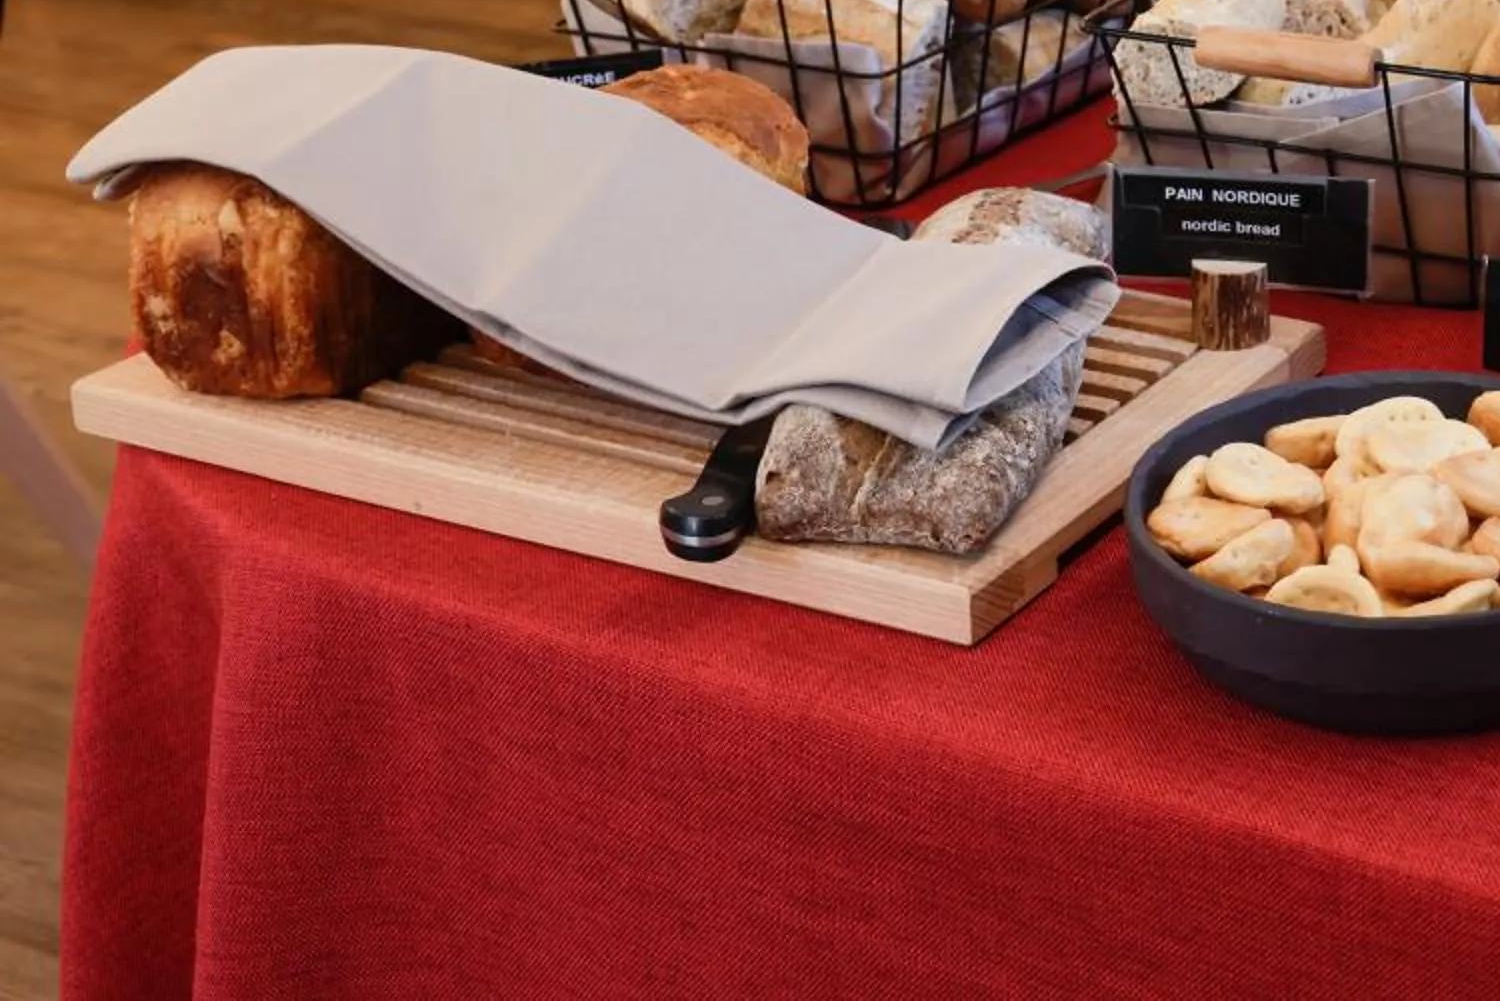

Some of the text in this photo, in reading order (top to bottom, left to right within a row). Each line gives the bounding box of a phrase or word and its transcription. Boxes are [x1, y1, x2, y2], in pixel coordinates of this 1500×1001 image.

[1164, 186, 1301, 208] PAIN NORDIQUE
[1181, 219, 1280, 236] nordic bread
